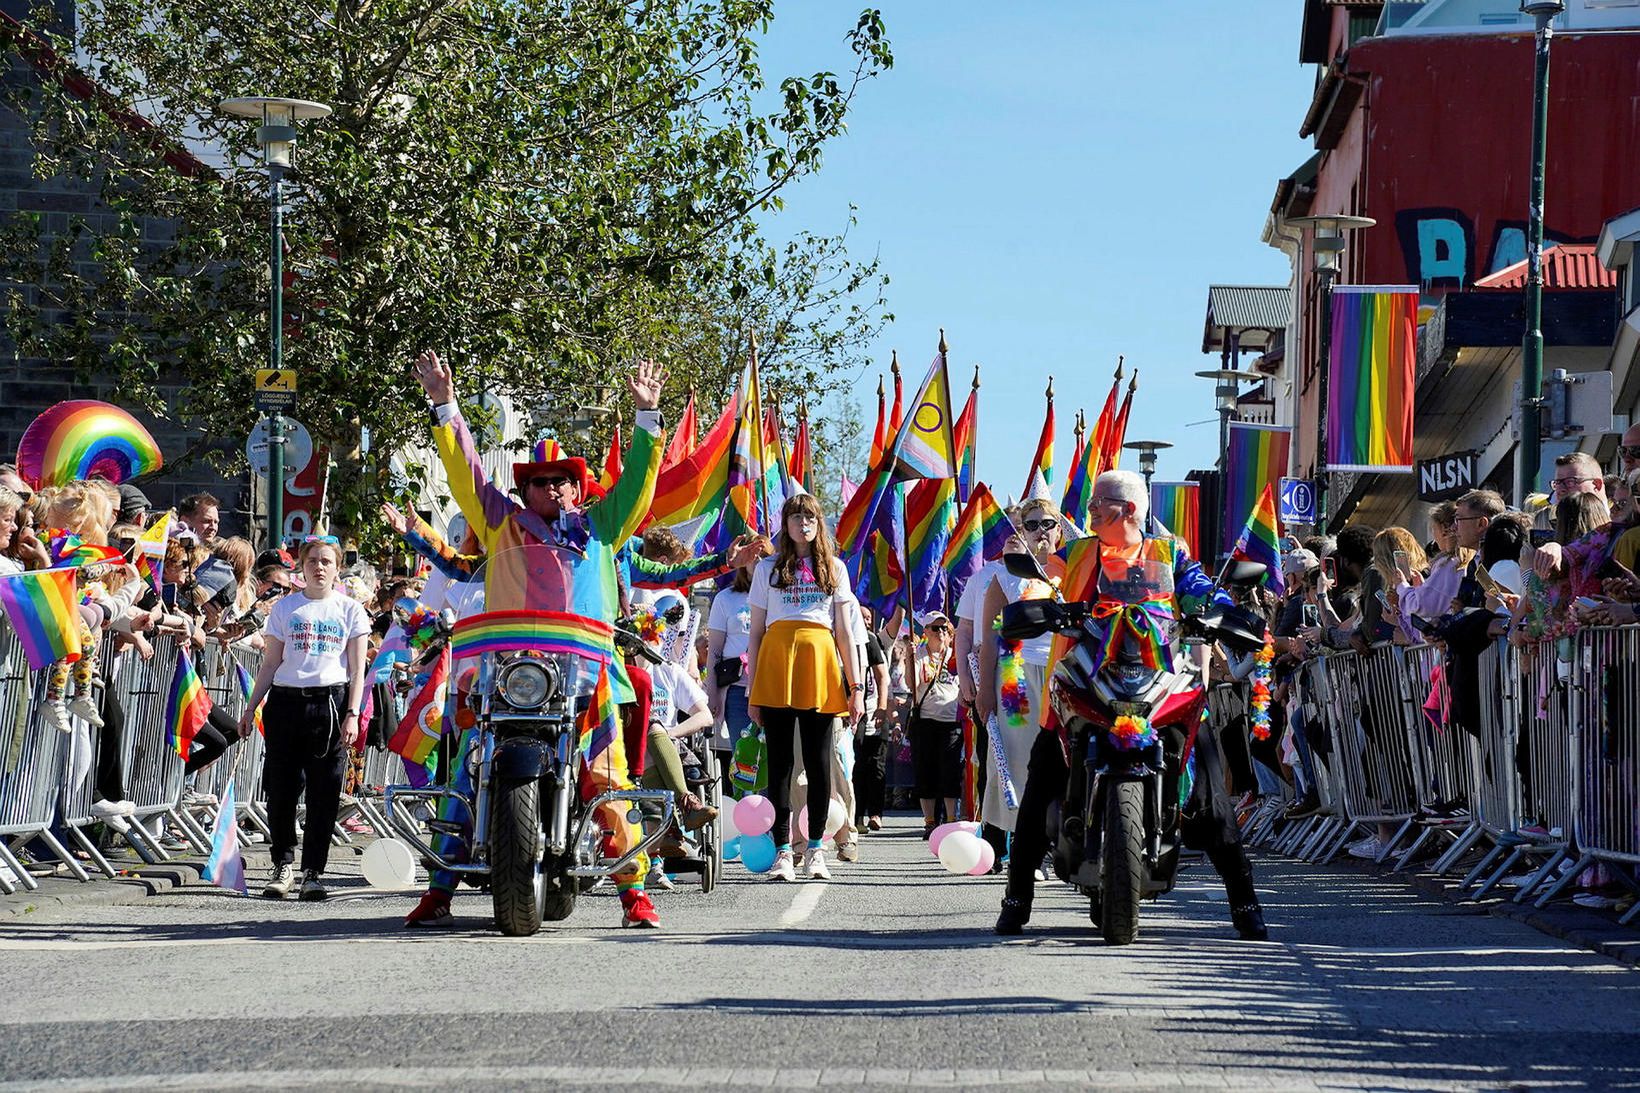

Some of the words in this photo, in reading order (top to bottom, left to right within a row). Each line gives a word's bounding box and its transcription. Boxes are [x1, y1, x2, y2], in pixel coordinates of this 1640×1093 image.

[1421, 455, 1472, 494] NLSN
[783, 595, 805, 604] TRANS
[293, 622, 316, 632] BESTA
[318, 624, 338, 634] LAND
[294, 642, 316, 651] TRANS
